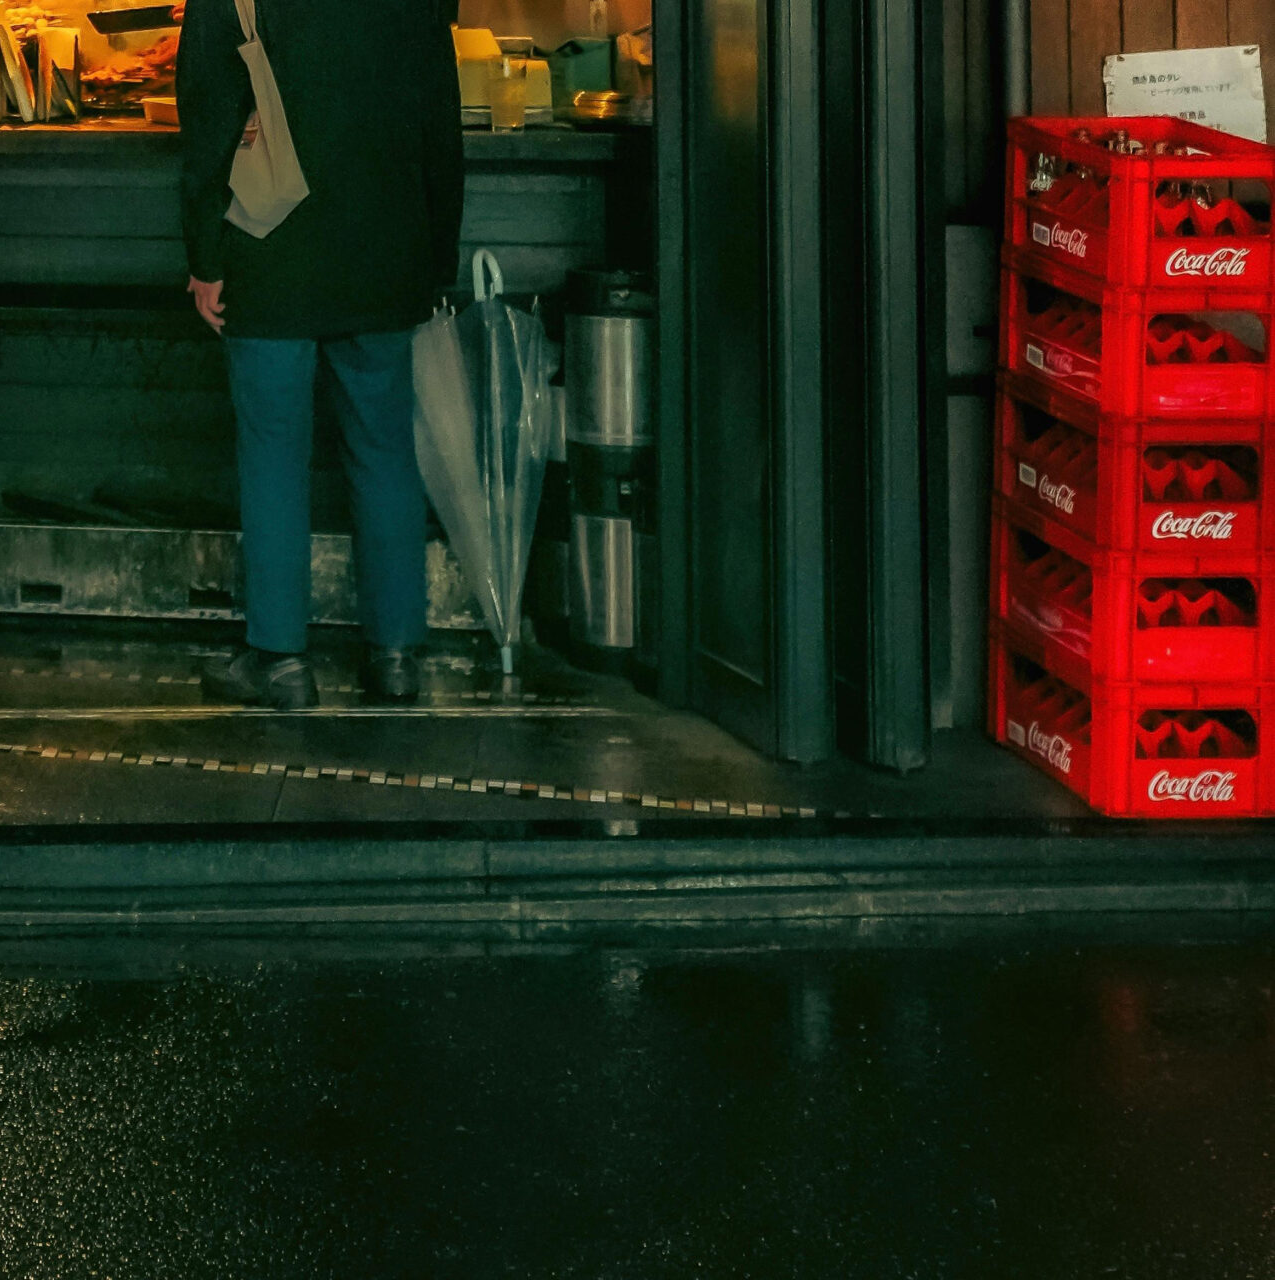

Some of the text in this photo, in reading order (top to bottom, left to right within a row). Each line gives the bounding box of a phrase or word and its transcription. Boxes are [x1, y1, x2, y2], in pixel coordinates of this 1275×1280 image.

[1166, 247, 1252, 276] Coca-Cola
[1152, 510, 1238, 539] Coca-Cola
[1148, 770, 1237, 802] Coca-Cola
